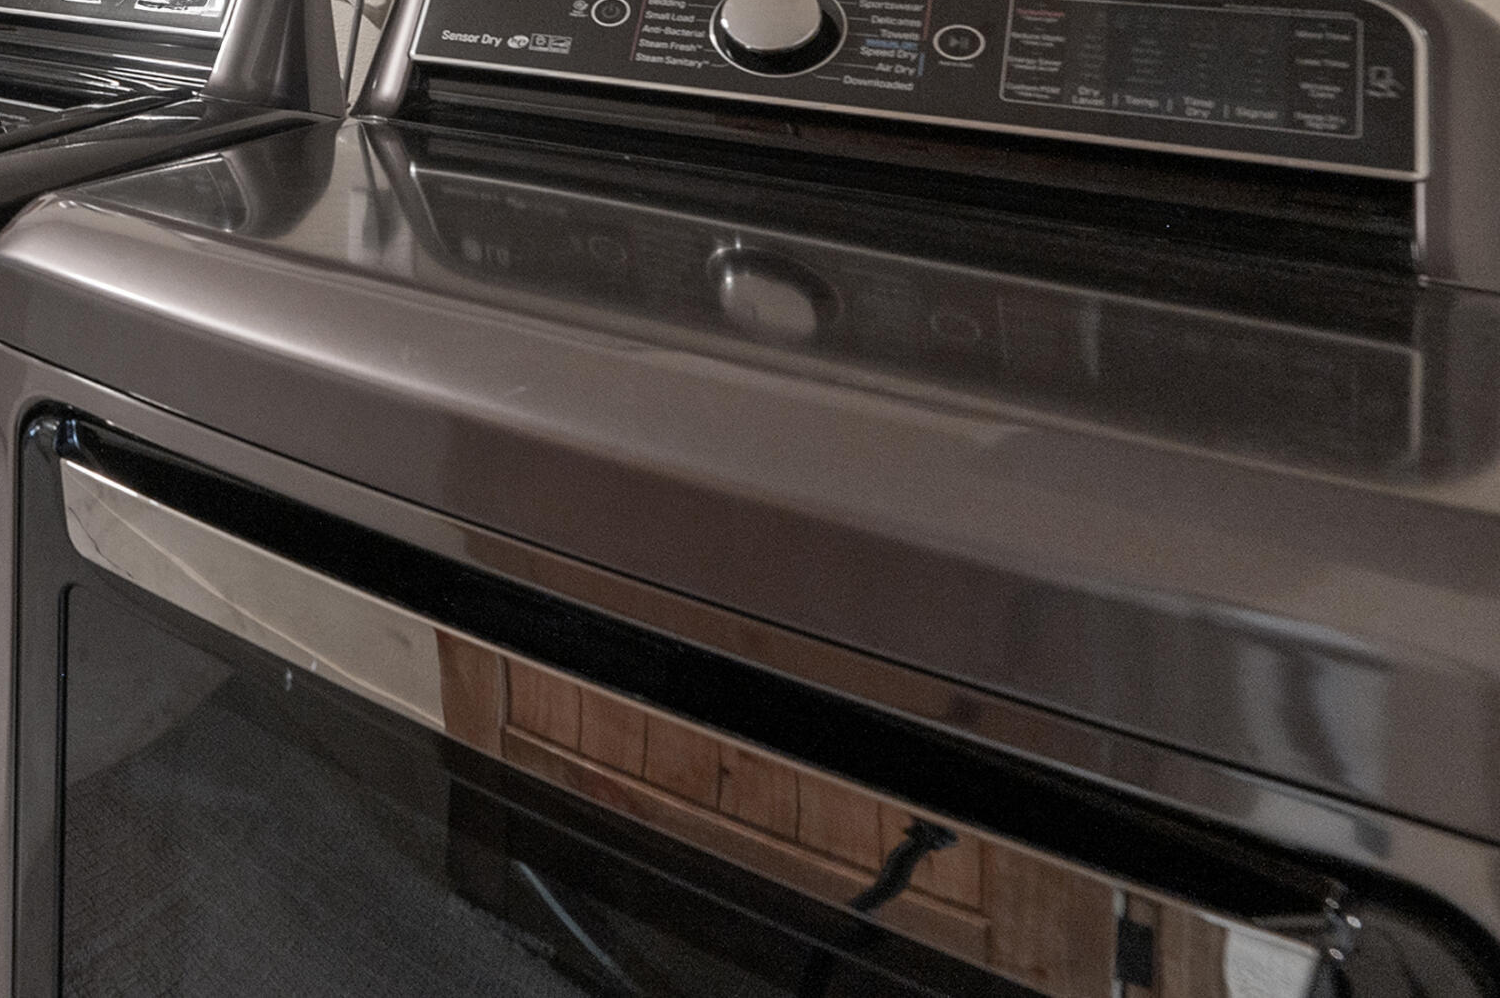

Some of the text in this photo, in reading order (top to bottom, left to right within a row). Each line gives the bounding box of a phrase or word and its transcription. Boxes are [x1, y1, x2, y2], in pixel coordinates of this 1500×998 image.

[644, 10, 696, 23] Small Load
[870, 15, 922, 28] Delicates
[441, 29, 503, 48] Sensor Dry
[879, 28, 920, 41] Towels
[638, 38, 668, 49] Steam
[635, 52, 665, 63] Steam
[859, 46, 919, 62] Speed Dry
[875, 62, 917, 76] Air Dry
[842, 75, 915, 92] Downloaded
